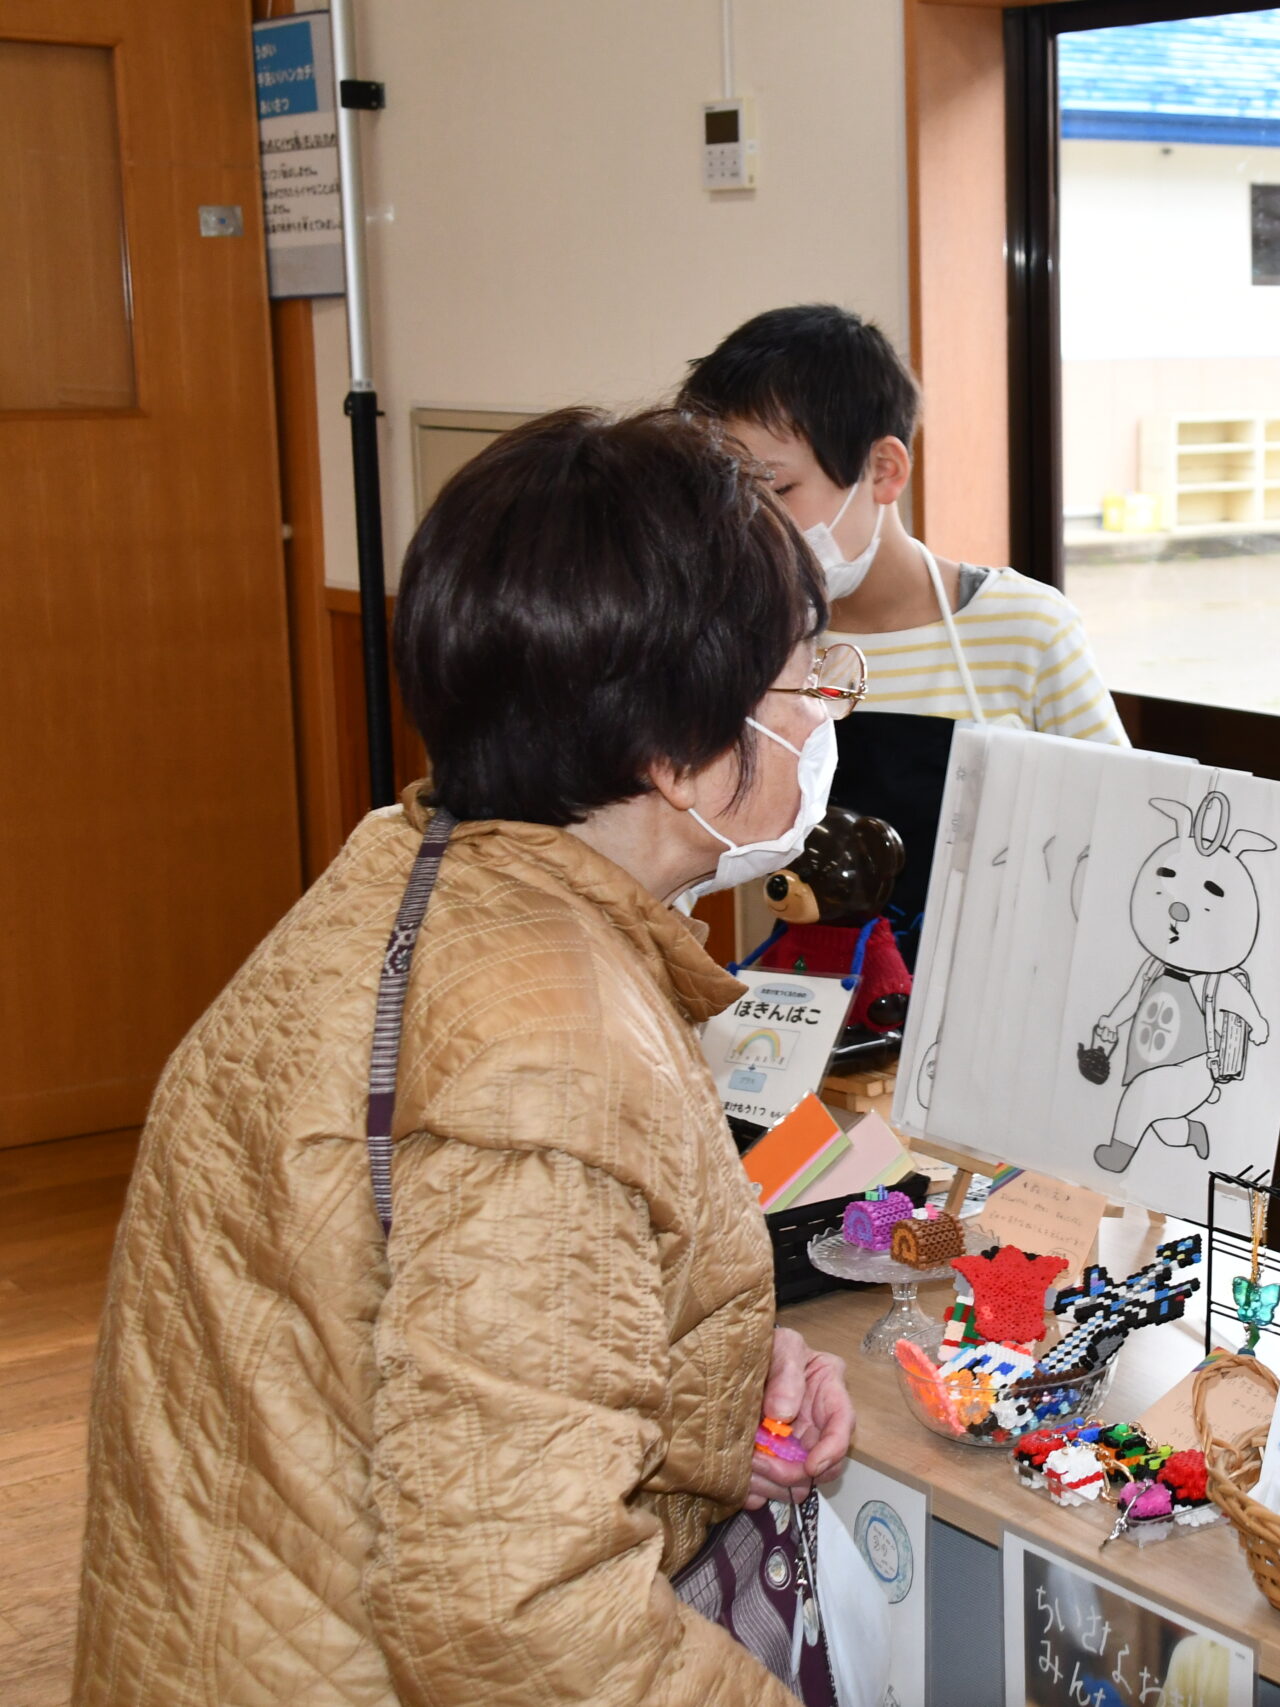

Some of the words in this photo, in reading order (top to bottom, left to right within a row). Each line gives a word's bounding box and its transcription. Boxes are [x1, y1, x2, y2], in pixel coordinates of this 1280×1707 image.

[734, 1001, 821, 1024] ぼきんばこ
